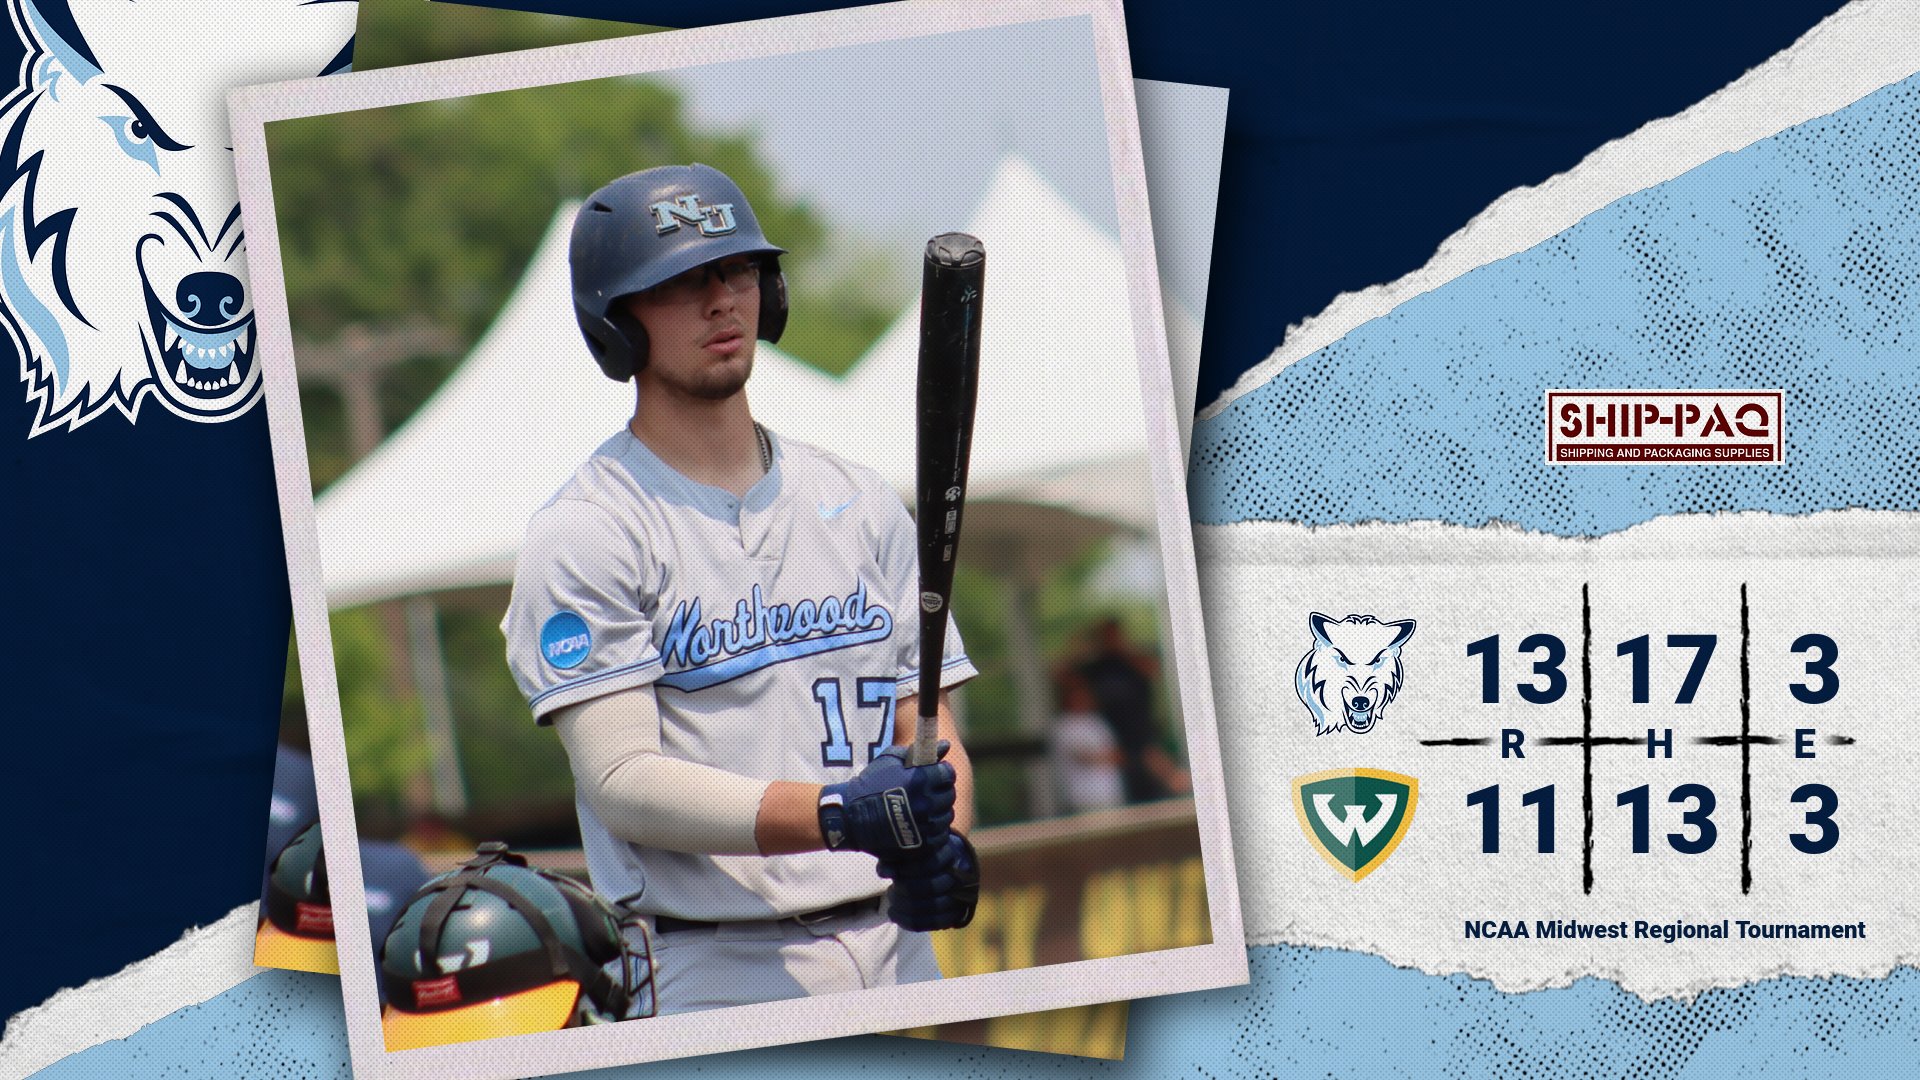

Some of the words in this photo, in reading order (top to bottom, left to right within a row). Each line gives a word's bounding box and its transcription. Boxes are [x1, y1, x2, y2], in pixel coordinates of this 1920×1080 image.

[648, 194, 737, 237] NU
[548, 633, 590, 658] NCAA
[658, 576, 894, 670] Northwood
[812, 676, 897, 767] 17
